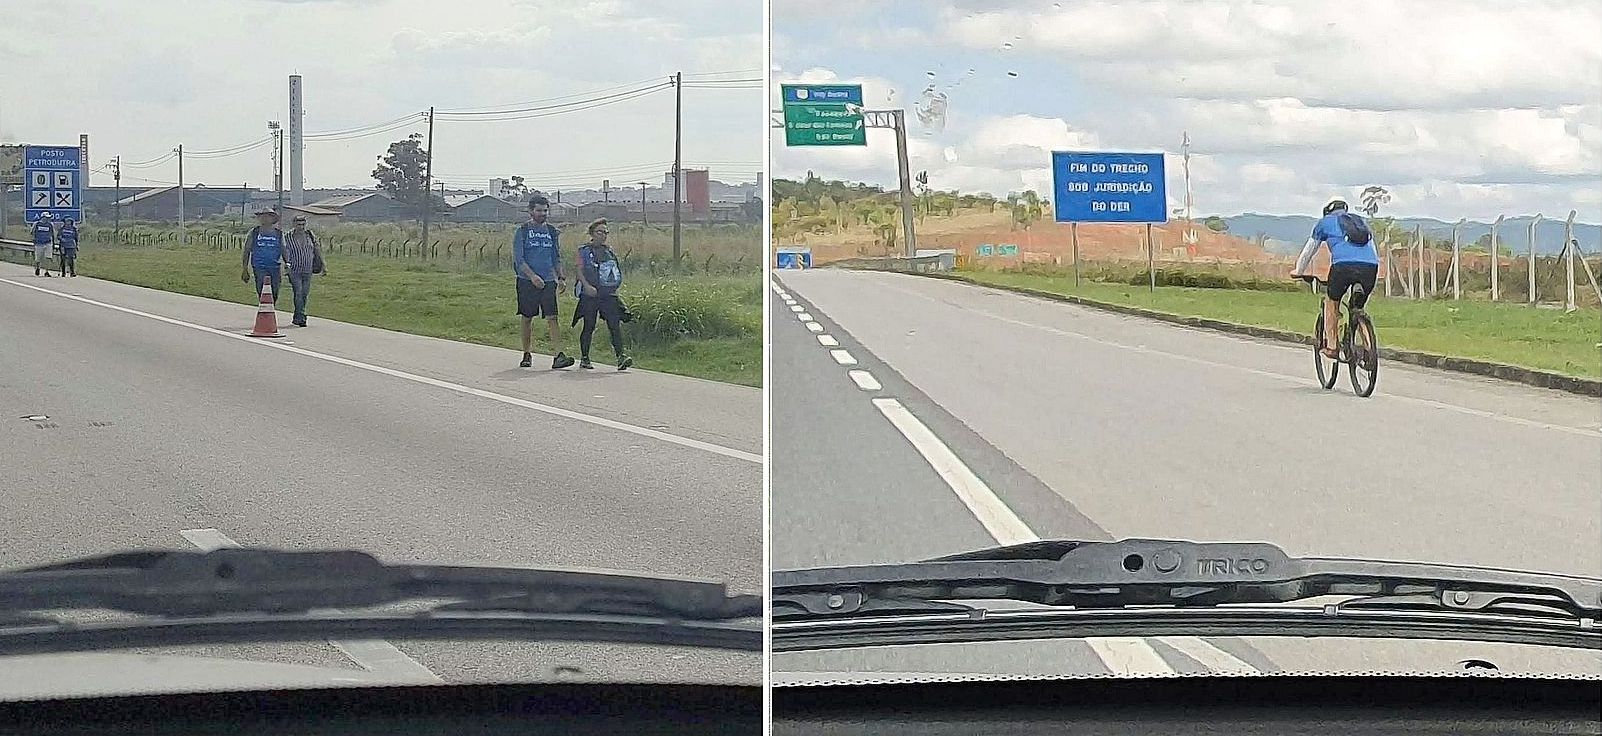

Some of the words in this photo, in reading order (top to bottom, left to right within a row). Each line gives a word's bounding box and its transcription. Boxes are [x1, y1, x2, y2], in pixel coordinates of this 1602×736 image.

[28, 158, 76, 167] PETRODUTRA
[1070, 162, 1088, 173] FIM
[1091, 162, 1106, 173] DO
[1110, 163, 1149, 174] TRECHO
[1092, 201, 1107, 212] DO
[1110, 201, 1130, 212] DER
[1197, 557, 1269, 576] TRICO
